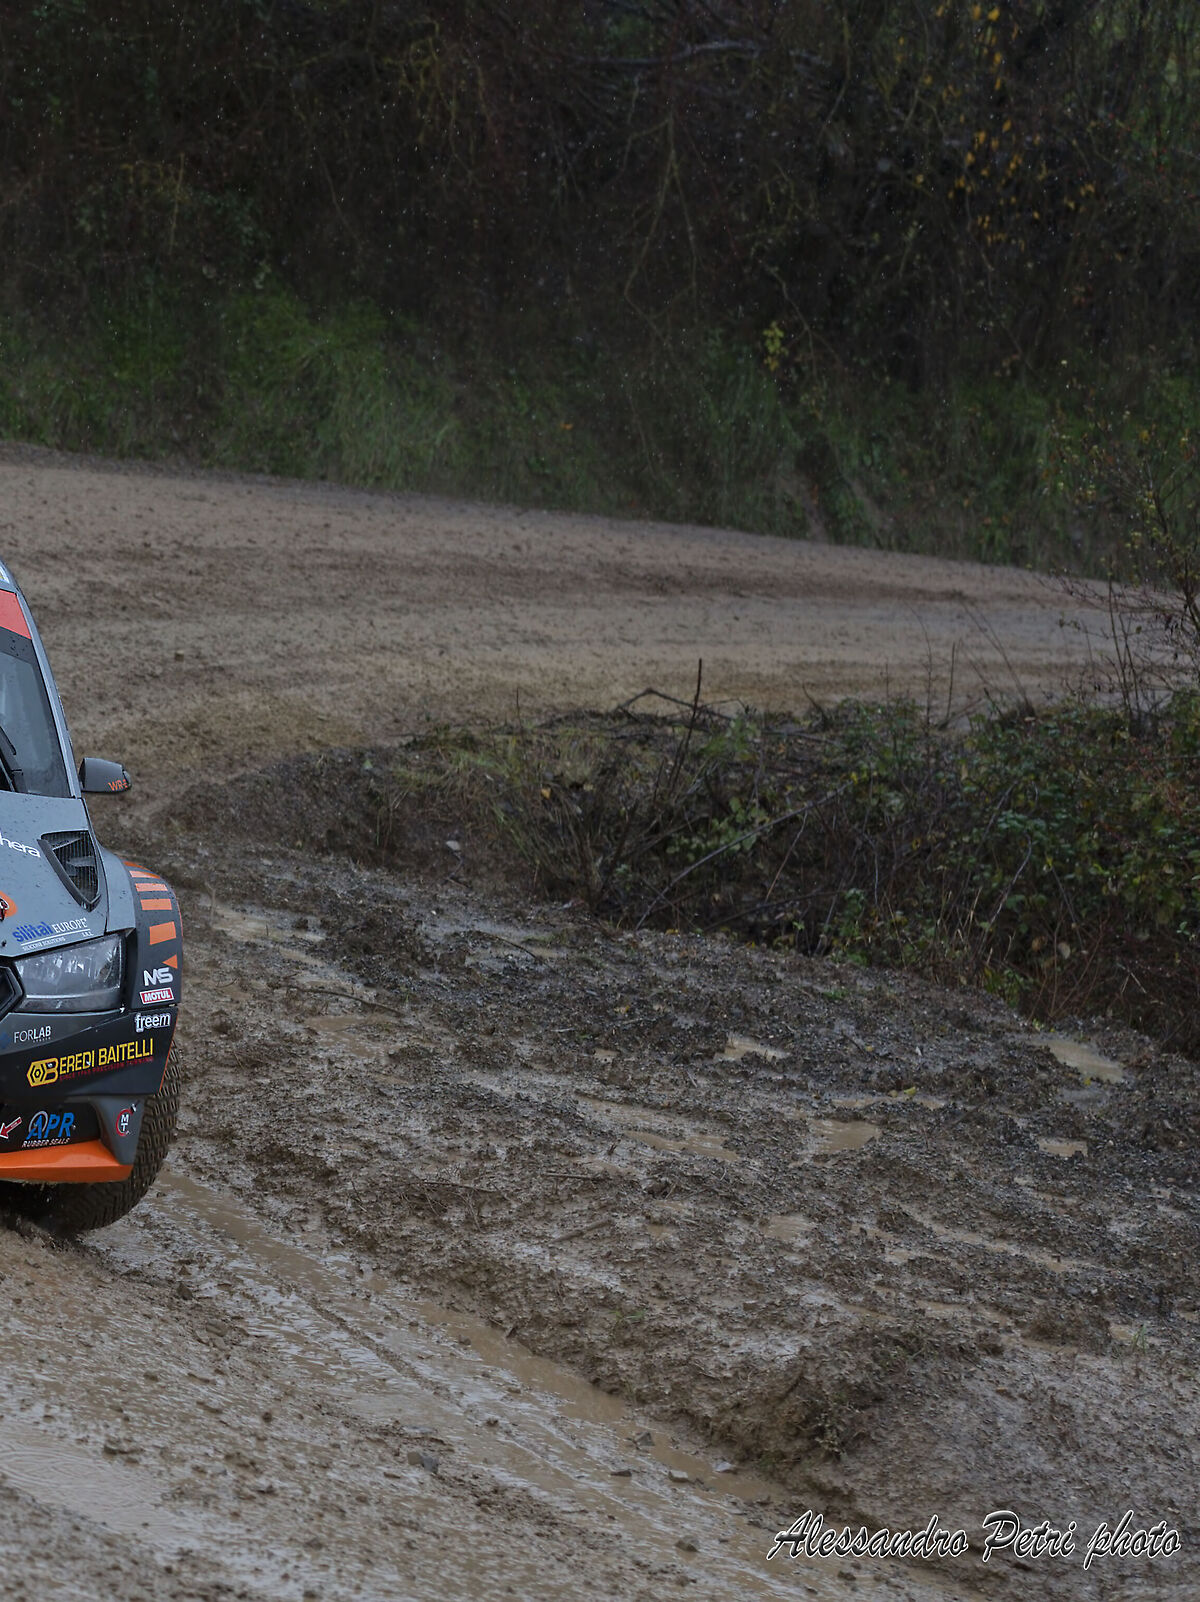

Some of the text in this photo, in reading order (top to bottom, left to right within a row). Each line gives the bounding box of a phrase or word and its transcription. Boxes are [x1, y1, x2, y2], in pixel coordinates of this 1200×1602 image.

[12, 922, 53, 942] silital
[144, 967, 173, 986] MS
[144, 991, 171, 1001] MOTUL
[134, 1013, 170, 1032] freem
[14, 1026, 51, 1042] FORLAB
[60, 1050, 94, 1074] EREDI
[98, 1038, 154, 1066] BAITELLI
[26, 1112, 74, 1140] APR
[50, 1138, 70, 1146] SEALS
